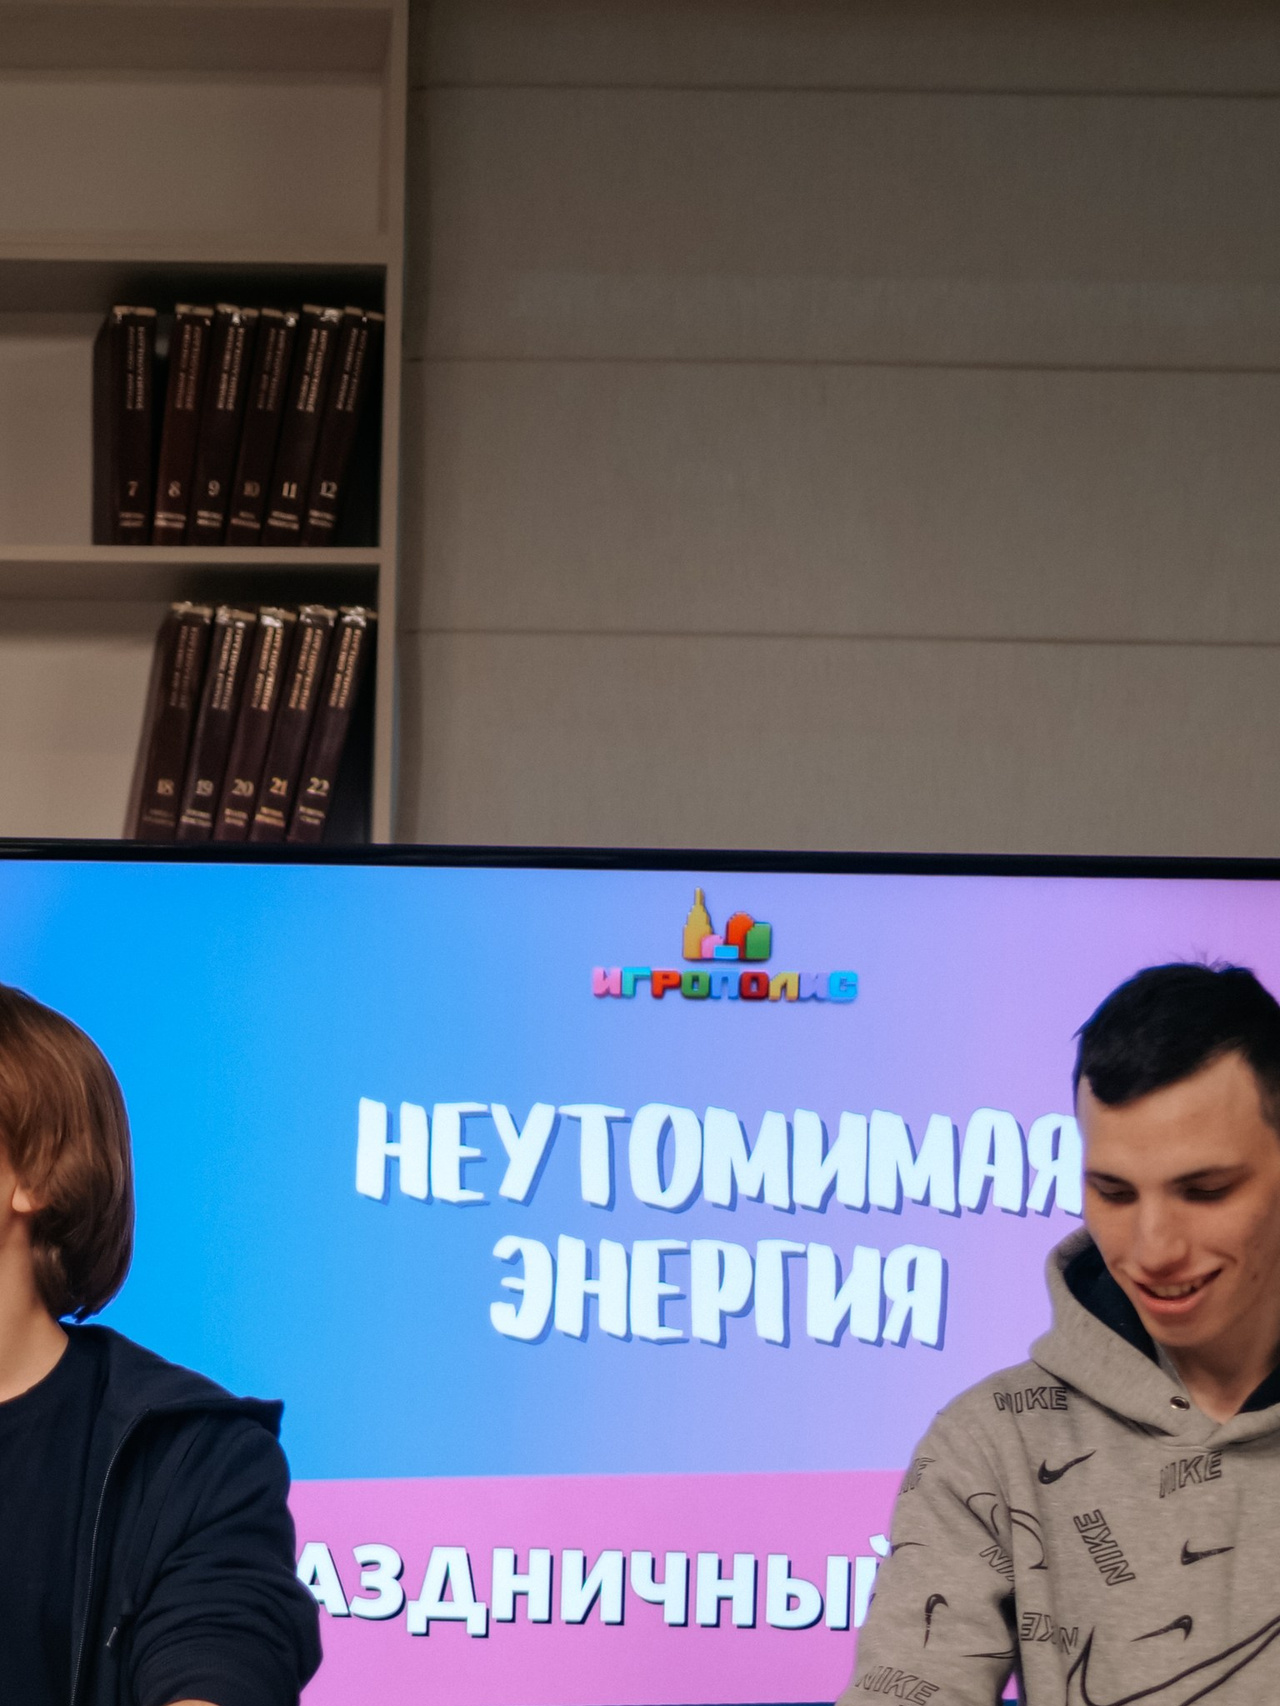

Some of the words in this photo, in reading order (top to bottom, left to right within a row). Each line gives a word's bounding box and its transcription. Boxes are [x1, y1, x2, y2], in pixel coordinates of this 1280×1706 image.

[128, 481, 138, 497] 7
[168, 480, 180, 497] 8
[208, 480, 220, 497] 9
[282, 481, 297, 498] 11
[320, 481, 337, 499] 12
[231, 778, 254, 798] 20
[269, 776, 288, 797] 21
[306, 776, 329, 797] 22
[592, 966, 858, 1003] ИГРОПОЛИС
[355, 1096, 1083, 1216] НЕУТОМИМАЯ
[489, 1233, 944, 1349] ЭНЕРГИЯ
[993, 1386, 1068, 1414] NIKE
[1073, 1508, 1136, 1586] NIKE
